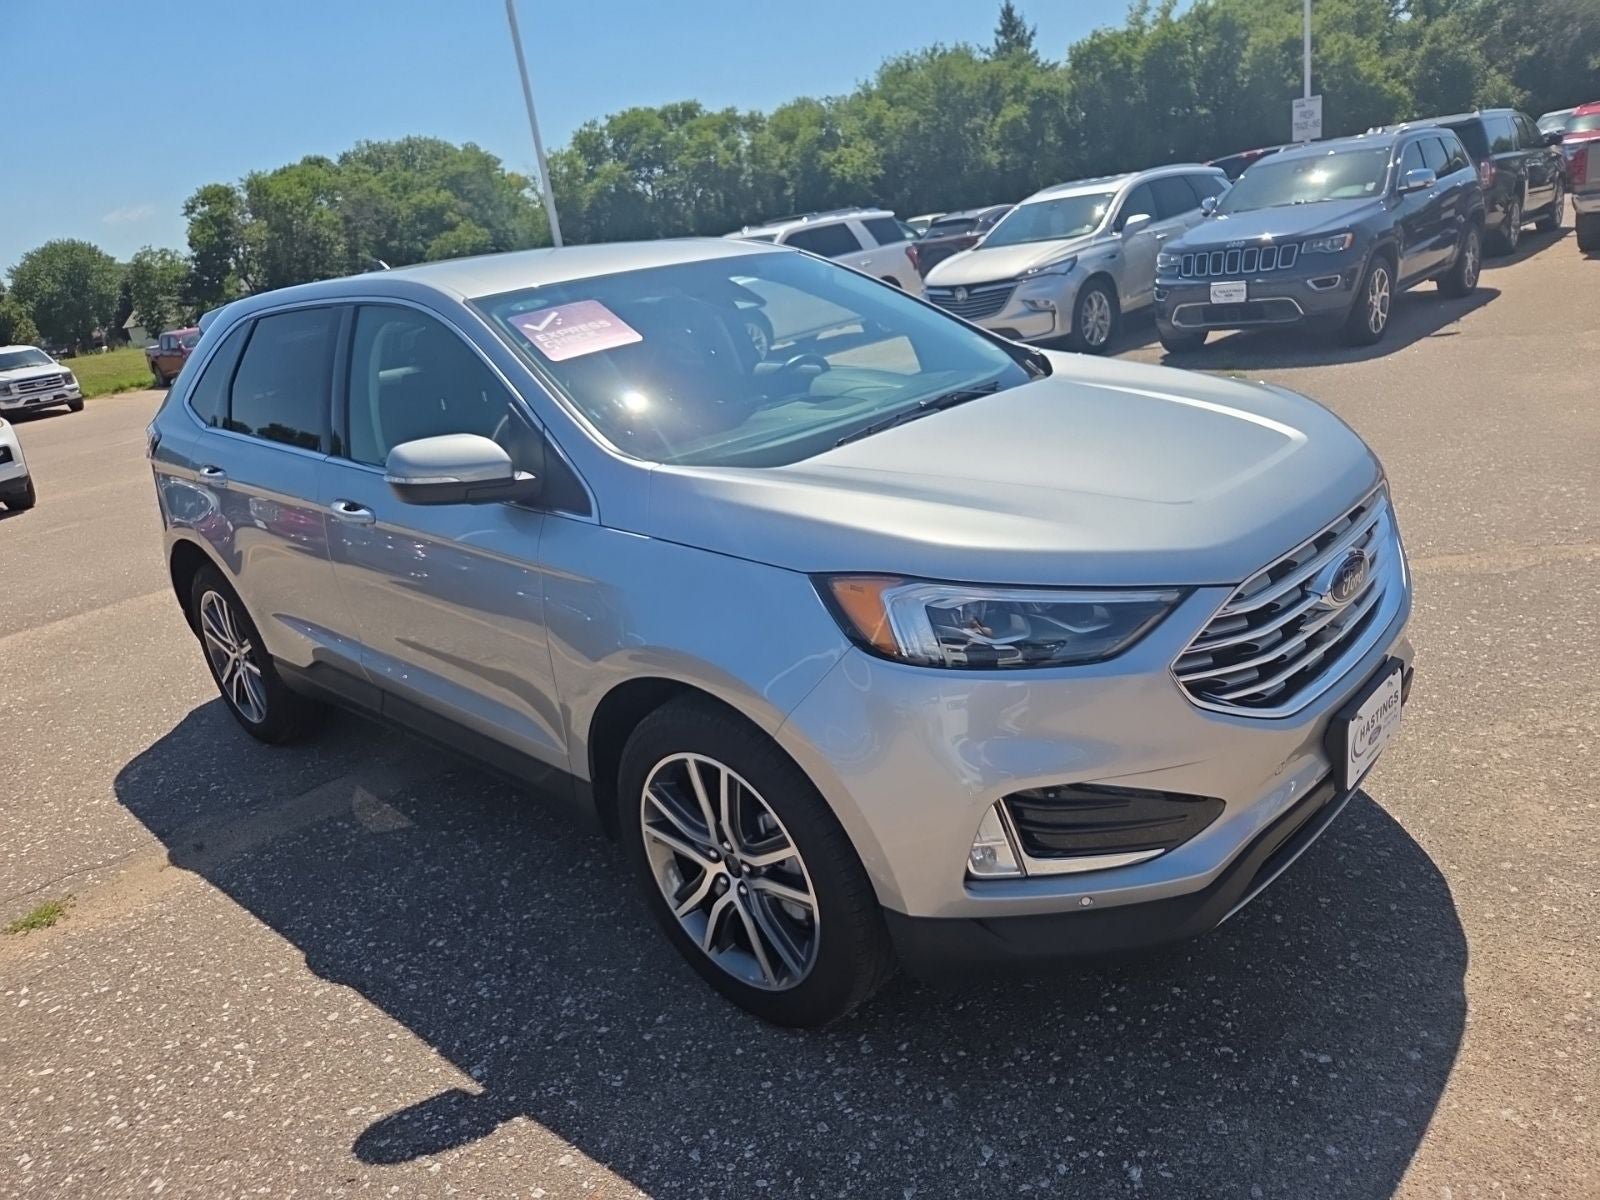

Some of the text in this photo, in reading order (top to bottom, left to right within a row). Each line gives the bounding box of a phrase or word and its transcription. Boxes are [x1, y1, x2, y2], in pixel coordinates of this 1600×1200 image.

[535, 319, 612, 342] EXPRESS
[1340, 560, 1367, 597] Ford
[1359, 690, 1399, 741] HASTINGS
